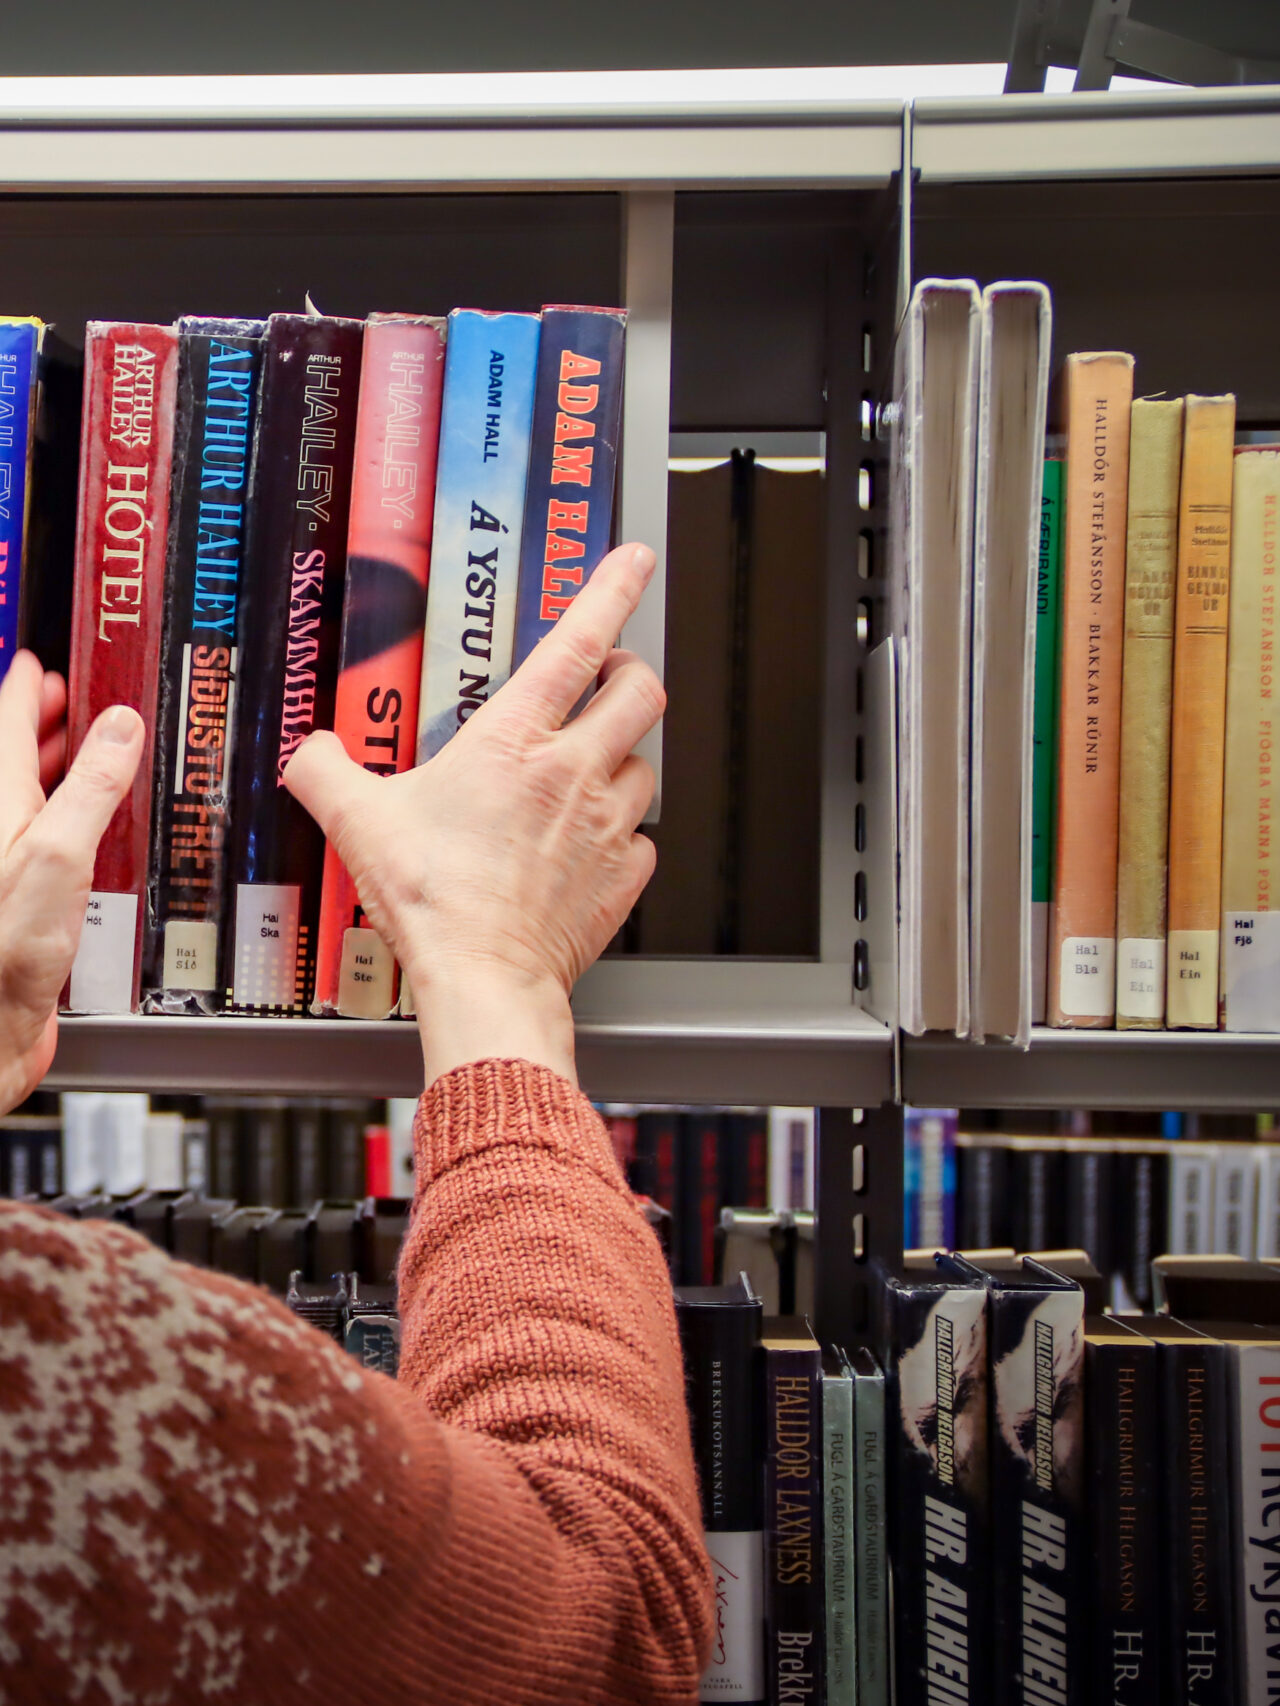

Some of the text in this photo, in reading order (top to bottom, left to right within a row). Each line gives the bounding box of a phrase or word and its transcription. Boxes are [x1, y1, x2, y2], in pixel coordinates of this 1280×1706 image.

[308, 354, 342, 364] ARTHUR
[392, 352, 425, 361] ARTHUR
[109, 342, 136, 448] HAILEY
[130, 344, 156, 449] ARTHUR
[483, 349, 505, 464] ADAM HALL
[296, 364, 342, 523] HAILEY
[381, 362, 425, 521] HAILEY
[192, 338, 254, 639] ARTHUR HAILEY
[539, 350, 602, 620] ADAM HALL
[470, 499, 510, 535] Á
[98, 461, 155, 643] HÓTEL
[460, 547, 499, 663] YSTU
[1085, 398, 1111, 774] HALLDÓR STEFÁNSSON BLAKKAR RÚNIR
[1258, 797, 1272, 860] MANNA
[260, 927, 280, 938] Ska
[262, 913, 279, 923] Hai
[1234, 919, 1254, 930] Hal
[1234, 935, 1253, 946] Fjö
[176, 948, 197, 957] Hai
[355, 955, 373, 965] Hai
[1075, 945, 1099, 956] Hal
[1075, 964, 1099, 974] Bla
[1130, 958, 1154, 970] Hal
[1179, 951, 1200, 962] Hal
[1179, 968, 1201, 980] Ein
[936, 1316, 957, 1486] HALLGRÍMUR HELGASON
[831, 1432, 844, 1468] FUGL
[831, 1471, 845, 1482] Á
[865, 1431, 877, 1466] FUGL
[1036, 1414, 1055, 1491] HELGASON
[775, 1489, 812, 1585] LAXNESS
[925, 1495, 968, 1566] HR.
[1022, 1500, 1067, 1572] HR.
[1119, 1505, 1137, 1613] HELGASON
[1190, 1505, 1209, 1613] HELGASON
[1113, 1629, 1143, 1692] HR.
[1186, 1629, 1216, 1692] HR.
